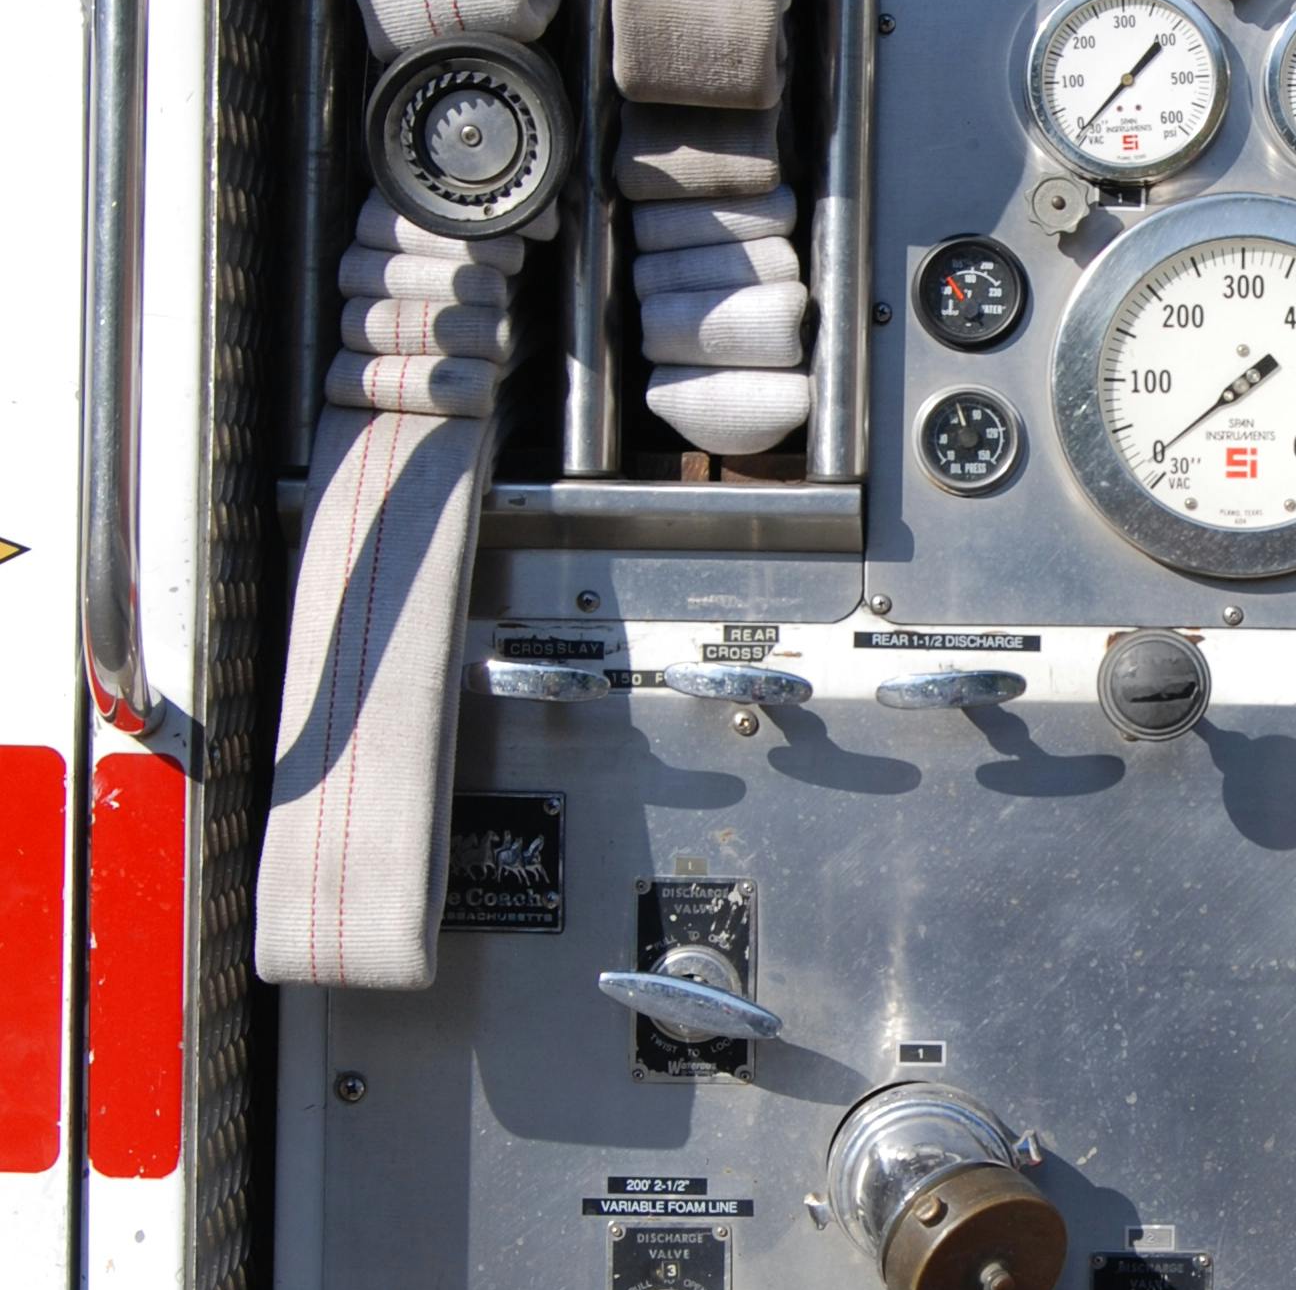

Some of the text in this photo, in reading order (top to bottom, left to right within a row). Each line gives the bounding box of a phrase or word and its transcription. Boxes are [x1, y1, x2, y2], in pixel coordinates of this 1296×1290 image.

[1114, 16, 1135, 28] 300
[1073, 36, 1095, 49] 200
[1062, 75, 1084, 88] 100
[1171, 72, 1193, 85] 500
[1161, 111, 1183, 124] 600
[1089, 136, 1104, 144] VAC
[1223, 275, 1264, 299] 300
[1163, 304, 1204, 328] 200
[1131, 370, 1171, 393] 100
[1228, 418, 1254, 429] SPAN
[1205, 431, 1276, 441] INSTRUMENTS
[951, 463, 986, 474] OIL PRESS
[1169, 478, 1190, 490] VAC
[731, 630, 776, 641] REAR
[872, 635, 1023, 649] REAR 1-1/2 DISCHARGE
[510, 643, 600, 655] CROSSLAY
[612, 674, 642, 686] 150
[467, 888, 542, 907] Coach
[662, 887, 729, 898] DISCHARGE
[918, 1049, 924, 1059] 1
[626, 1180, 689, 1192] 200' 2-1/2"
[601, 1201, 737, 1213] VARIABLE FOAM LINE
[637, 1234, 703, 1244] DISCHARGE
[649, 1250, 690, 1259] VALVE
[667, 1265, 677, 1277] 3
